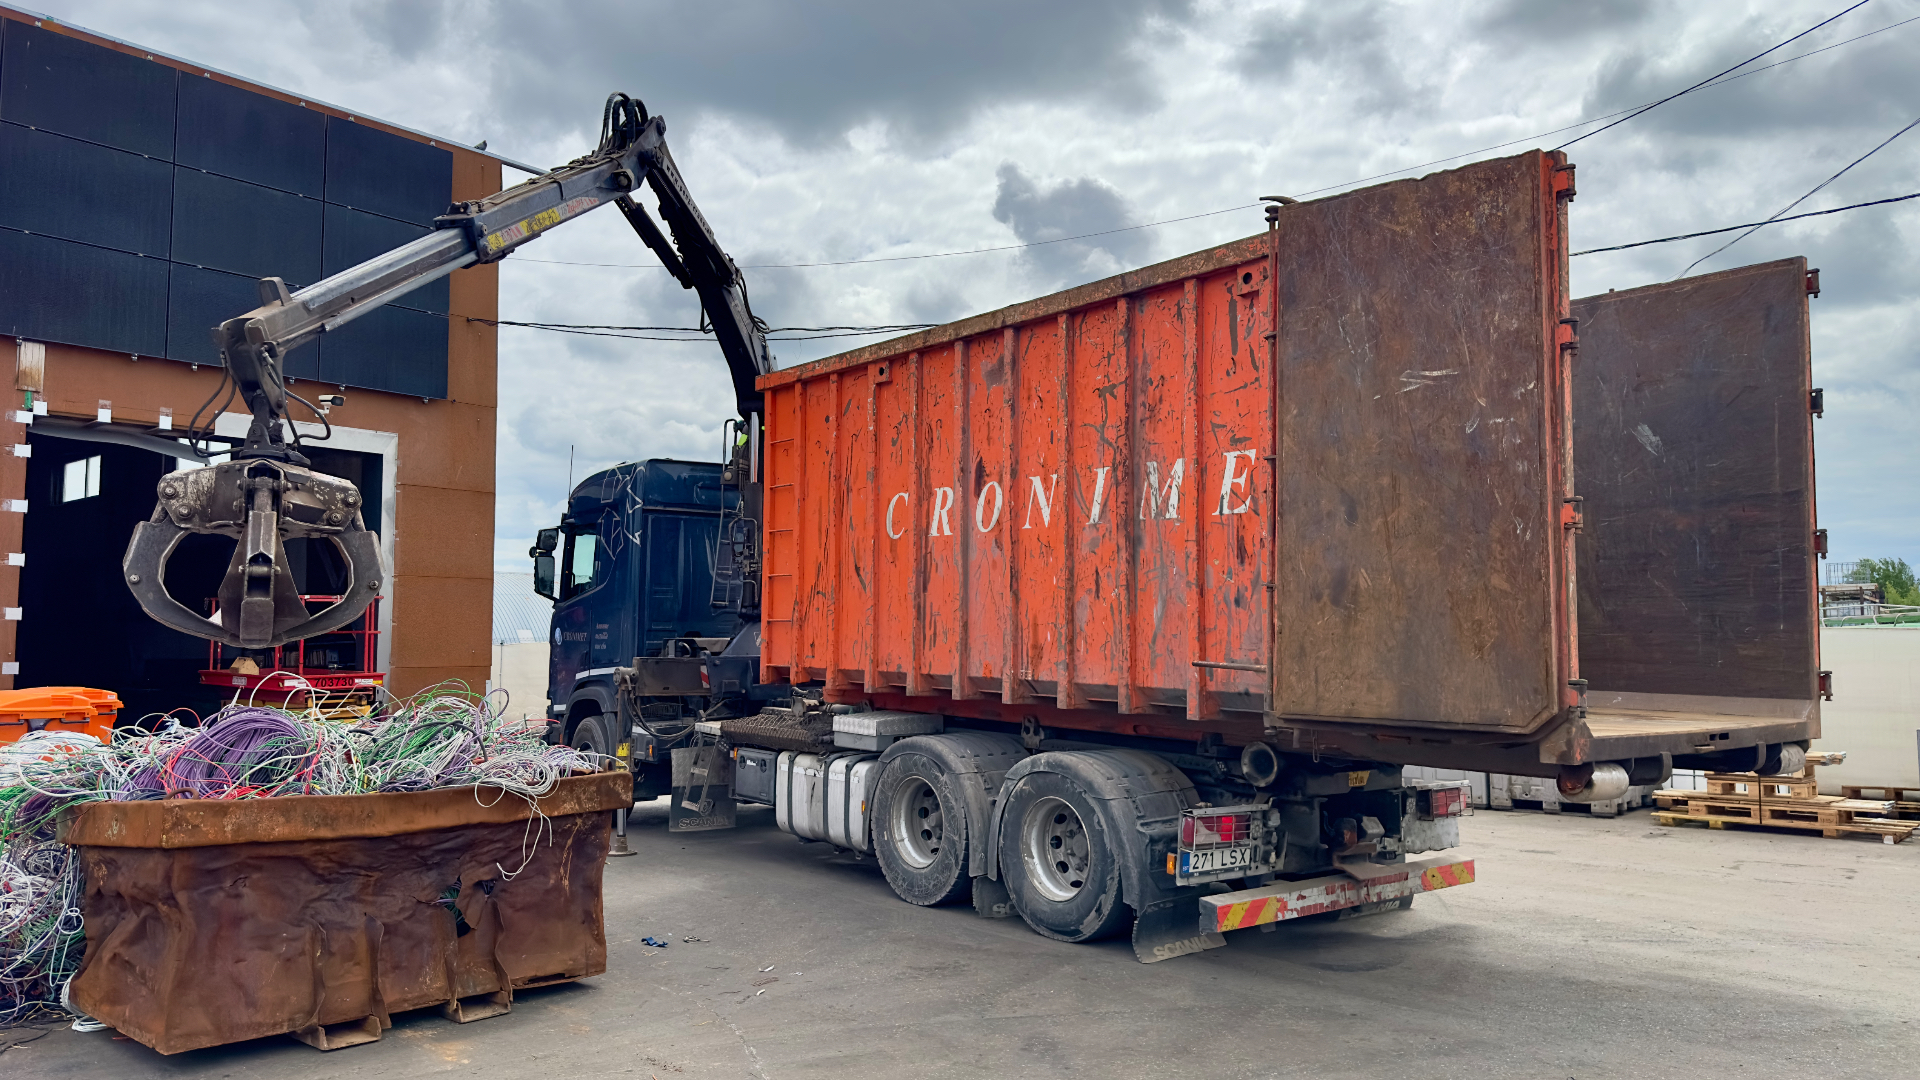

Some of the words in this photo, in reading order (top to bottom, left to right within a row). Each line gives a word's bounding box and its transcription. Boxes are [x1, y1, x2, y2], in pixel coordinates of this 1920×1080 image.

[314, 677, 355, 688] 703730
[678, 815, 729, 829] SCANIA
[1192, 852, 1215, 871] 271
[1220, 848, 1249, 867] LSX
[1152, 934, 1213, 960] SCANIA
